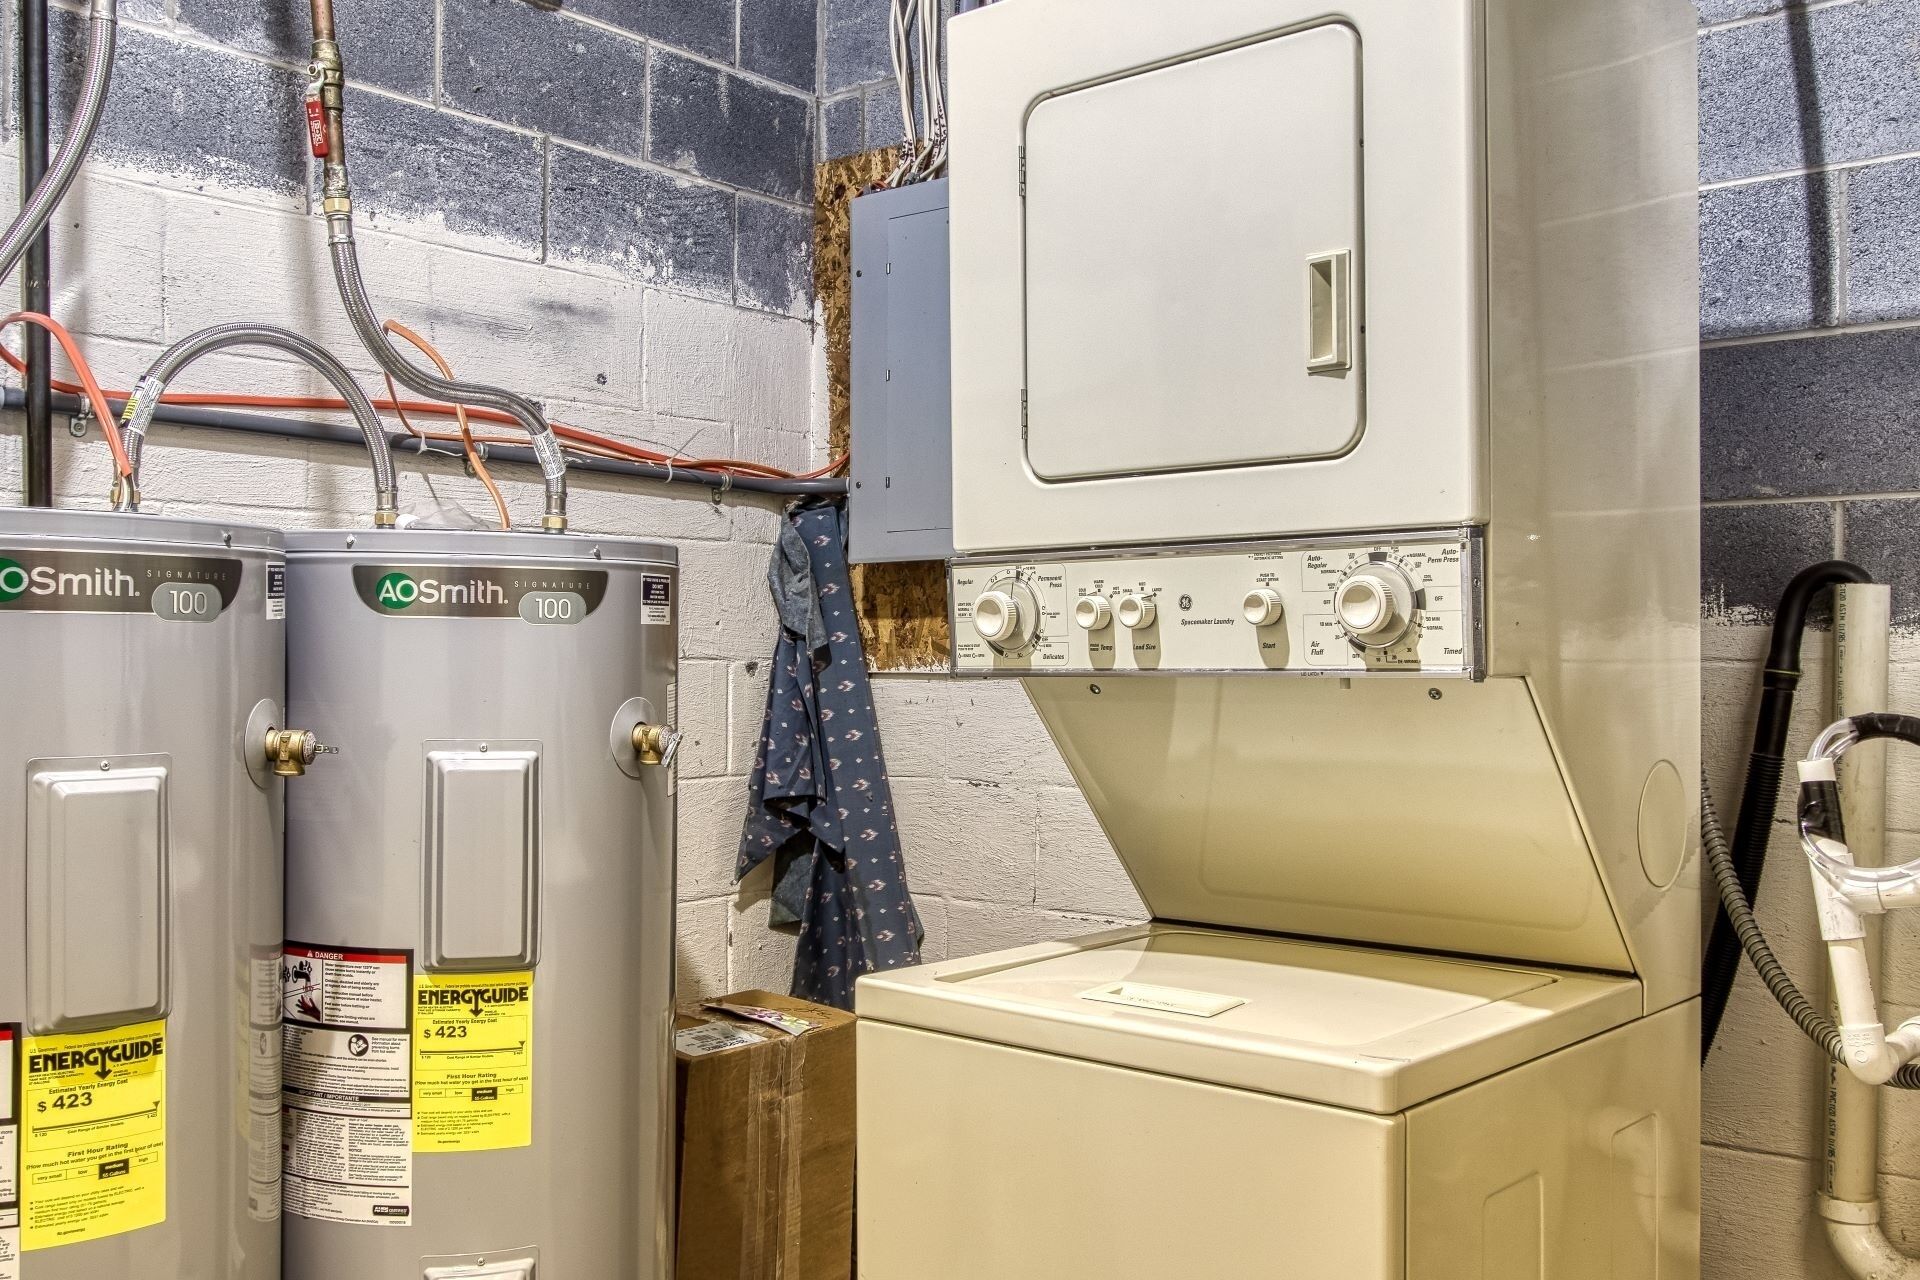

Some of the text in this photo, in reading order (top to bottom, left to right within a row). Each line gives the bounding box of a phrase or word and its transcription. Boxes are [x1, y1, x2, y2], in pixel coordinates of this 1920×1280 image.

[0, 566, 133, 596] OSmith
[146, 569, 226, 581] SIGNATURE
[514, 580, 590, 590] SIGNATURE
[169, 590, 208, 614] 100
[535, 598, 571, 619] 100
[315, 952, 343, 960] DANGER
[418, 987, 528, 1005] ENERGYGUIDE
[424, 1026, 467, 1038] $ 423
[29, 1037, 163, 1074] ENERGYGUIDE
[49, 1086, 76, 1094] Estimated
[97, 1081, 115, 1089] Energy
[37, 1092, 93, 1113] $ 423
[106, 1142, 128, 1151] Rating
